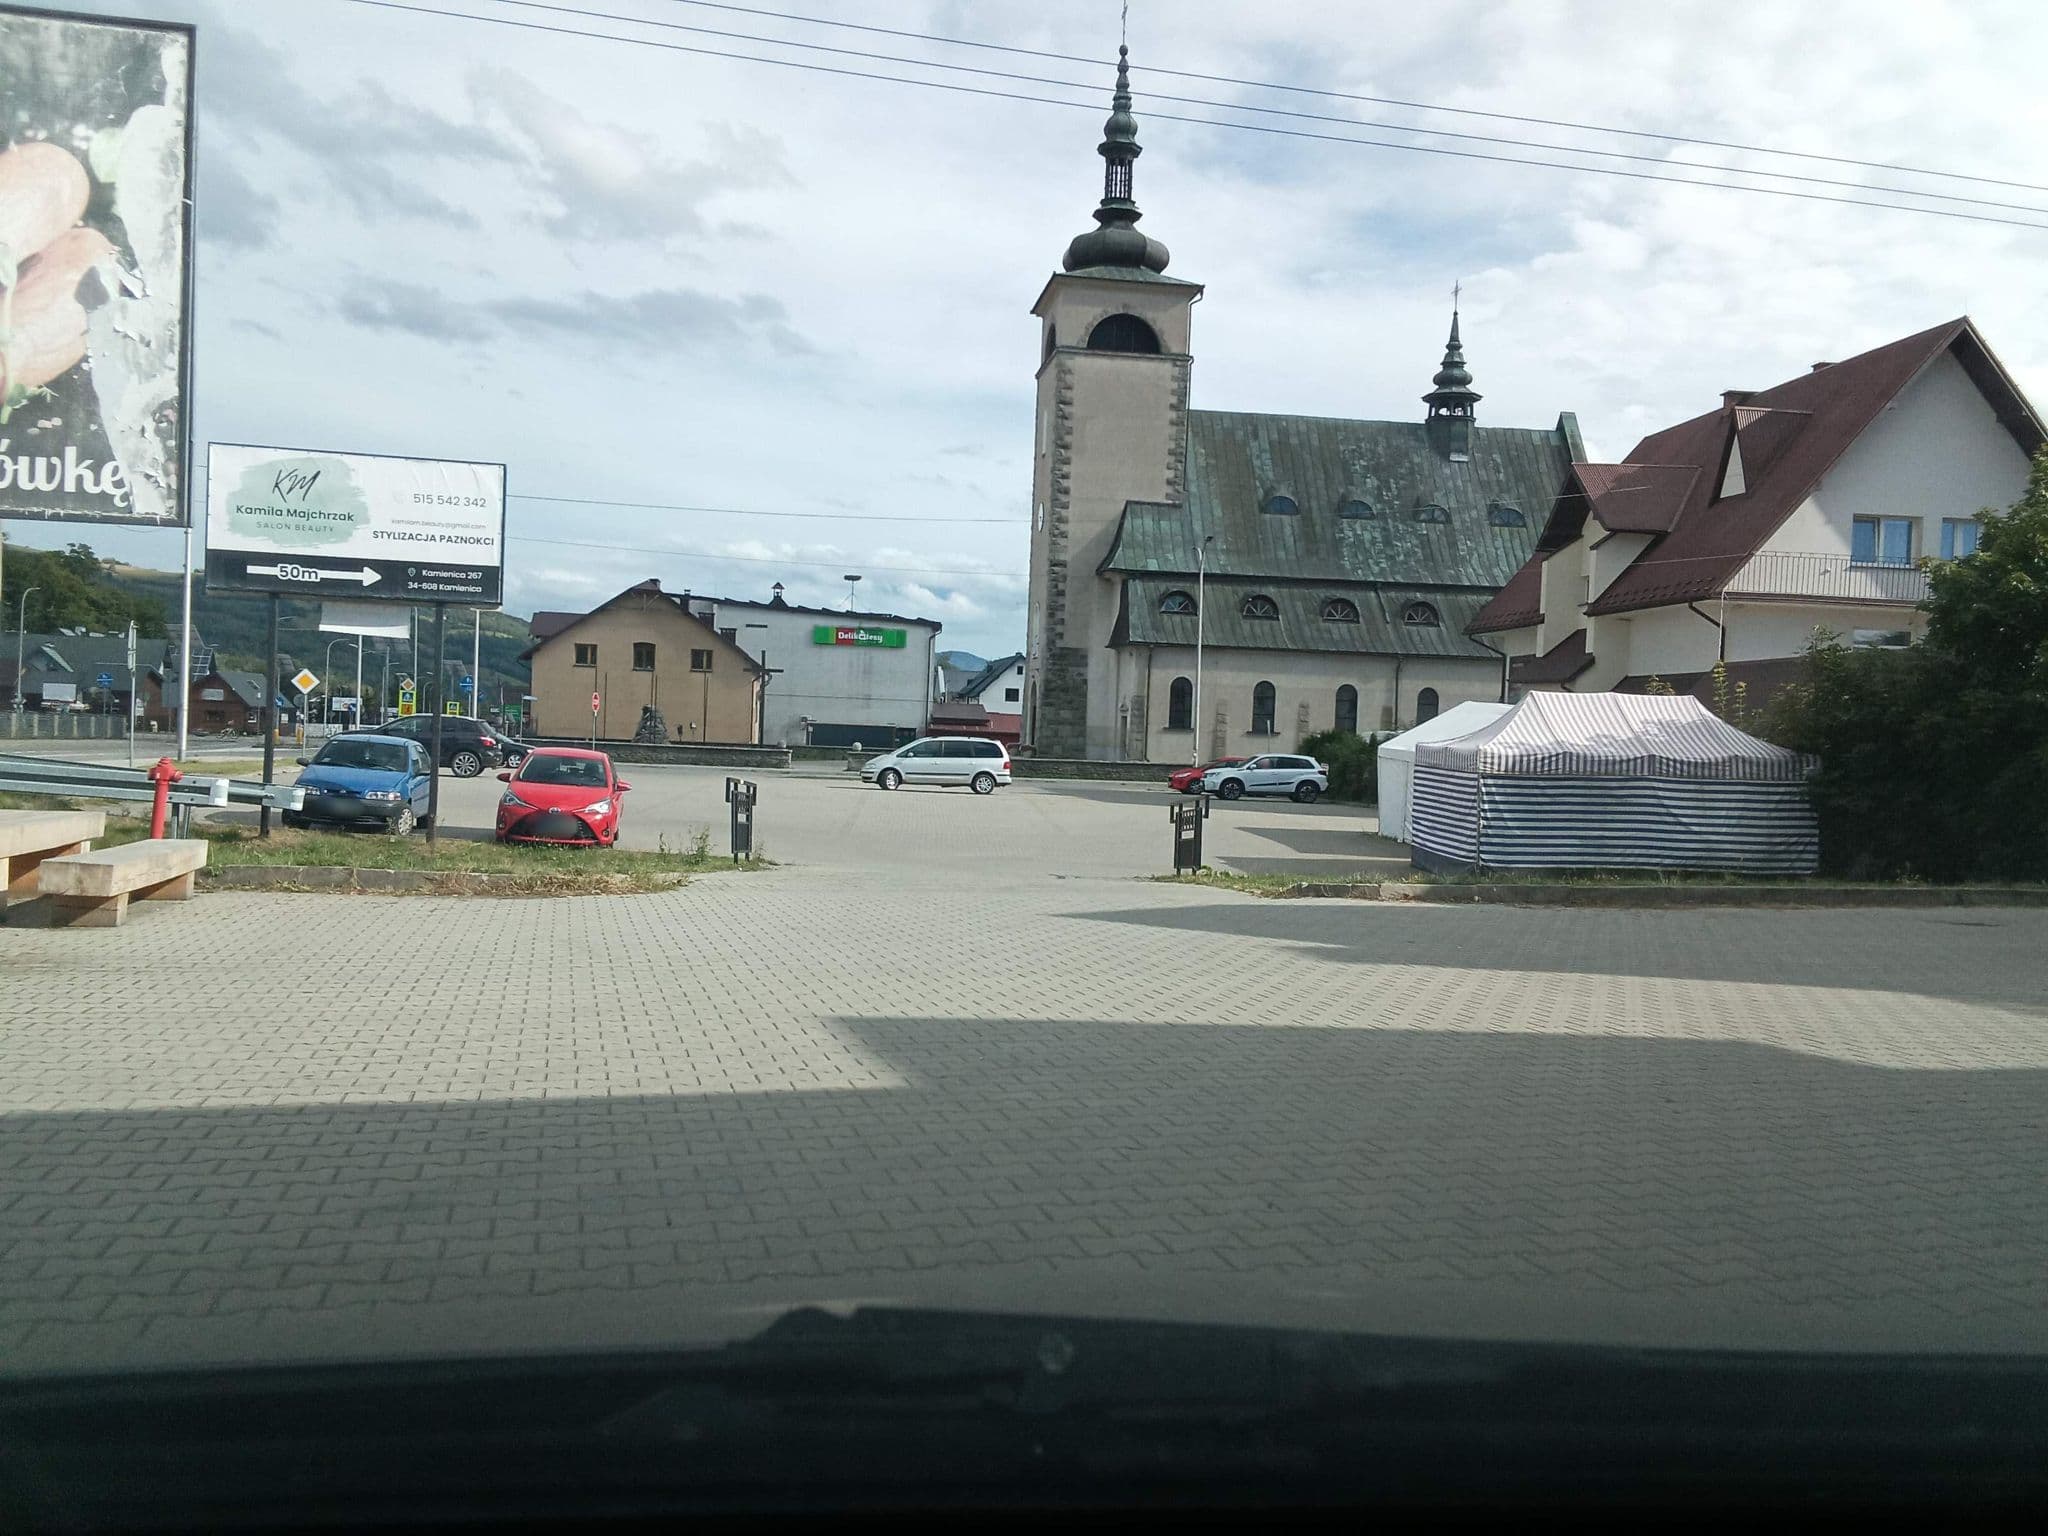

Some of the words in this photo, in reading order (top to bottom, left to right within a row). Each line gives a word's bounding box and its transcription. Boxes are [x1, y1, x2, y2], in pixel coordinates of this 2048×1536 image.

[413, 493, 434, 505] 515
[437, 495, 461, 507] 542
[463, 497, 487, 508] 342
[236, 505, 283, 517] Kamila
[286, 508, 355, 522] Majchrzak
[256, 521, 291, 530] SALON
[294, 524, 334, 532] BEAUTY
[372, 530, 437, 543] STYLIZACJA
[439, 534, 495, 546] PAZNOKCI
[278, 564, 319, 581] 50m
[422, 569, 466, 579] Kamienica
[407, 581, 438, 591] 34-608
[439, 583, 482, 593] Kamienica
